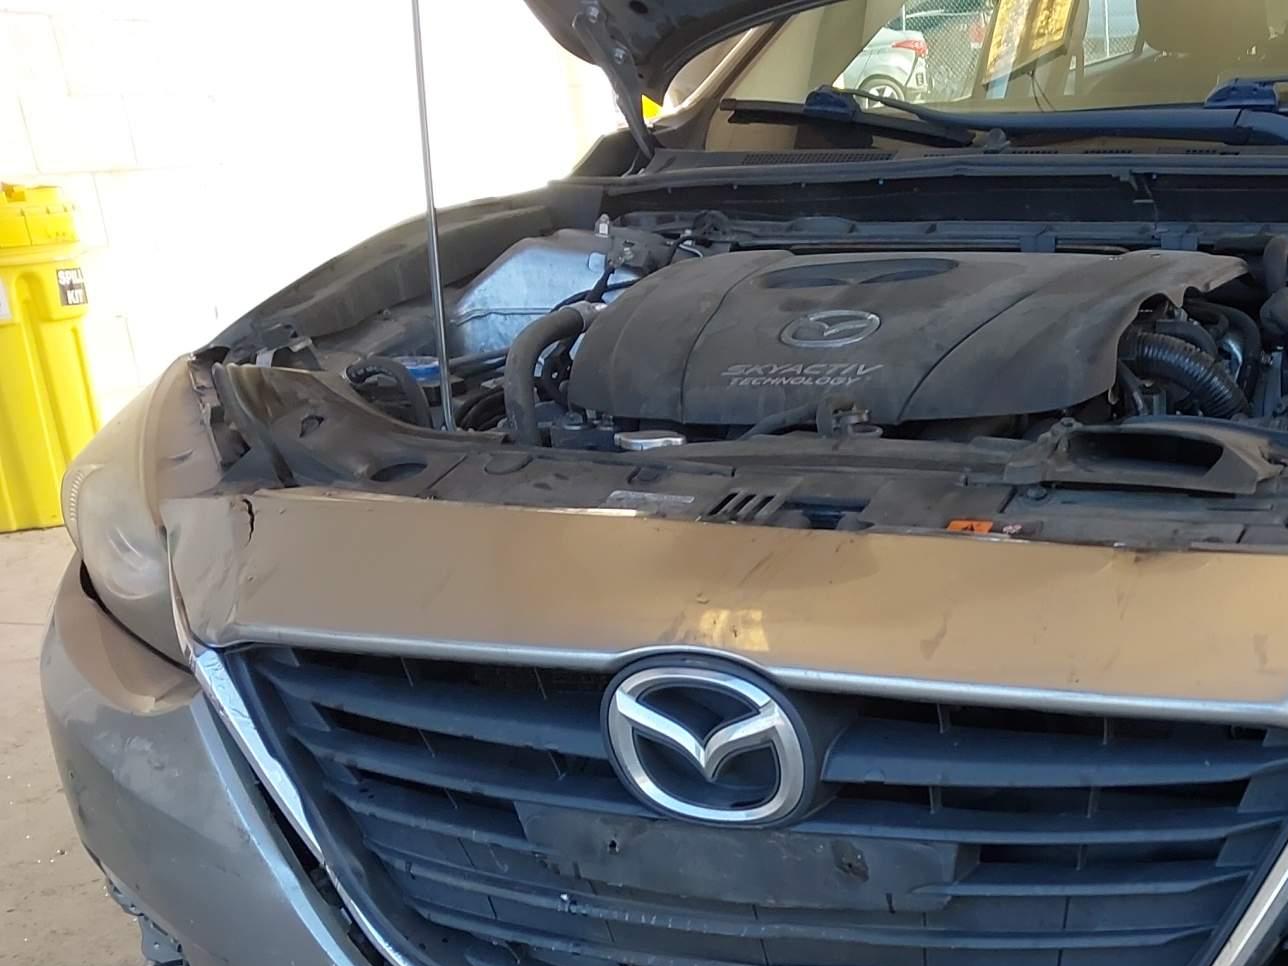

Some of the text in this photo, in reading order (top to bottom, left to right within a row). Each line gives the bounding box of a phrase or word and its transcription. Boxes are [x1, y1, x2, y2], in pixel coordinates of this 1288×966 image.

[66, 288, 85, 305] KIT
[721, 362, 884, 377] SKYACTIV
[729, 375, 863, 387] TECHNOLOGY
